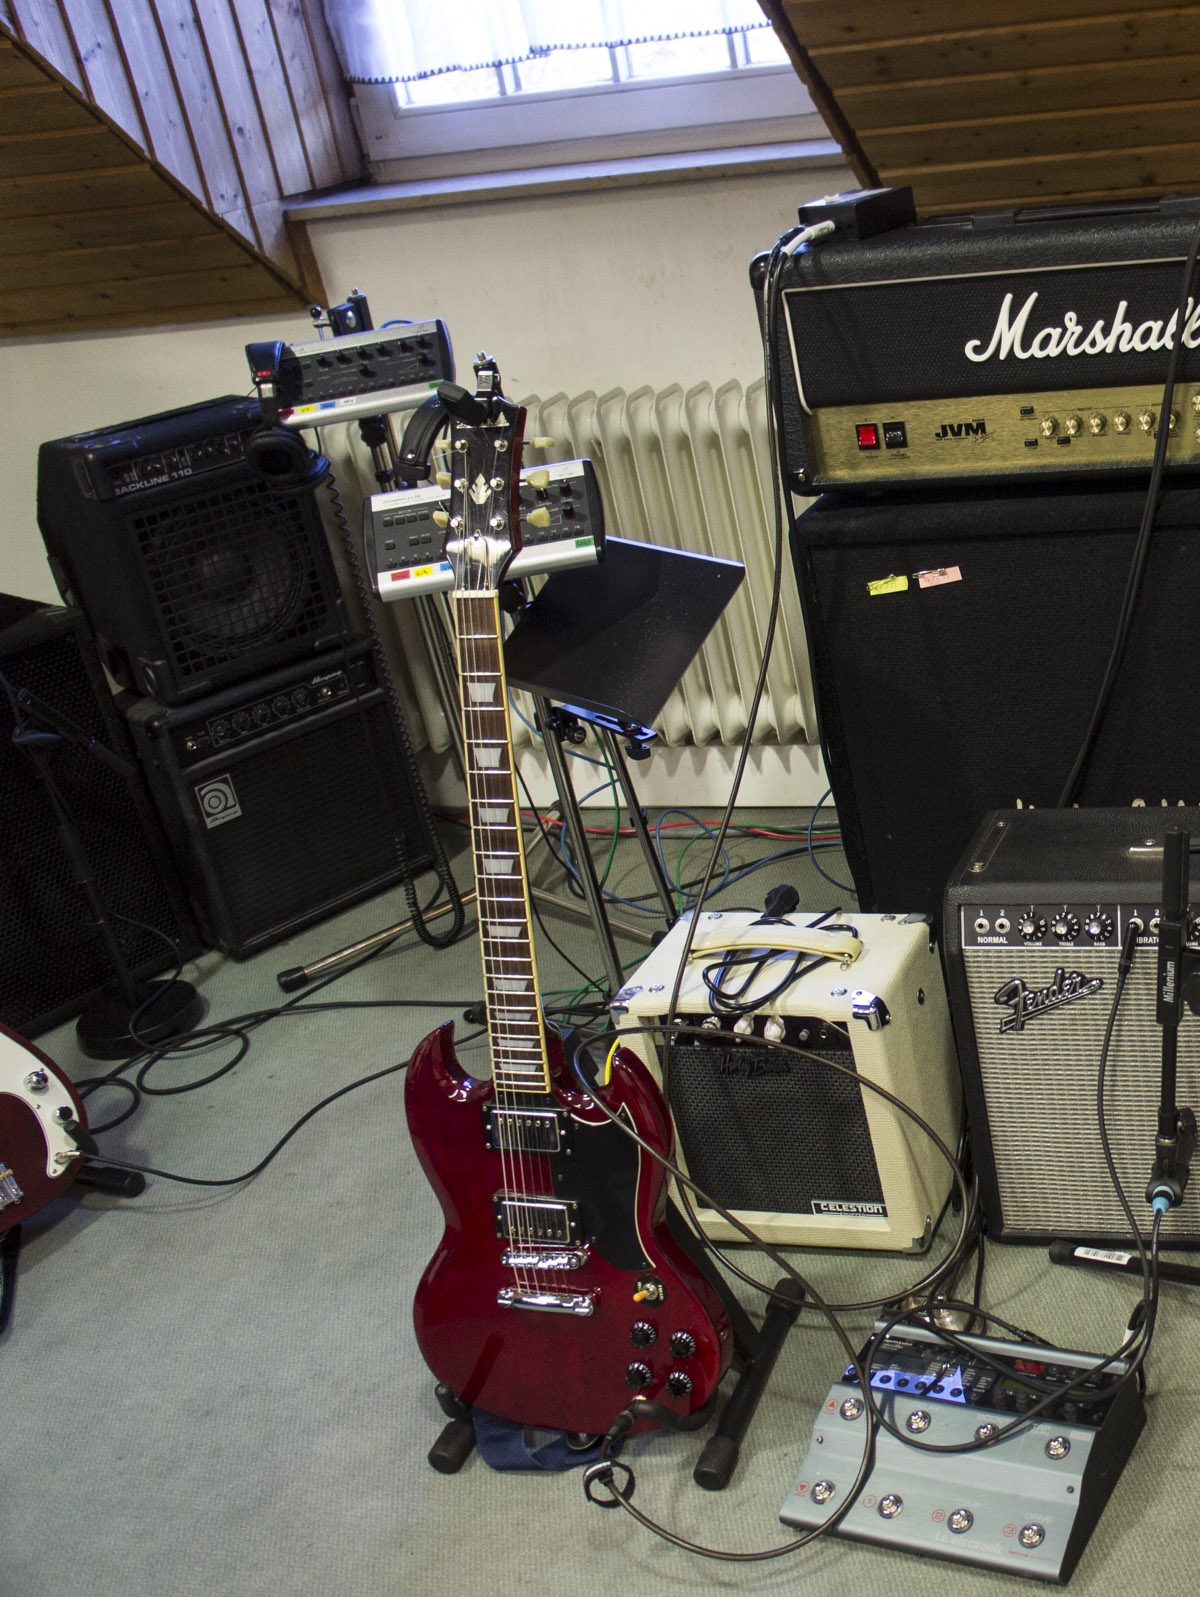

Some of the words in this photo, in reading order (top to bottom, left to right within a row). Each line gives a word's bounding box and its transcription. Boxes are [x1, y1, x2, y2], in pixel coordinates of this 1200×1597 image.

[935, 422, 986, 438] JVM
[114, 473, 170, 496] BACKLINE
[171, 467, 193, 479] 110
[977, 936, 1008, 944] NORMAL
[1162, 960, 1175, 1003] Millenium
[994, 967, 1104, 1033] Fender
[820, 1202, 883, 1213] CELESTION
